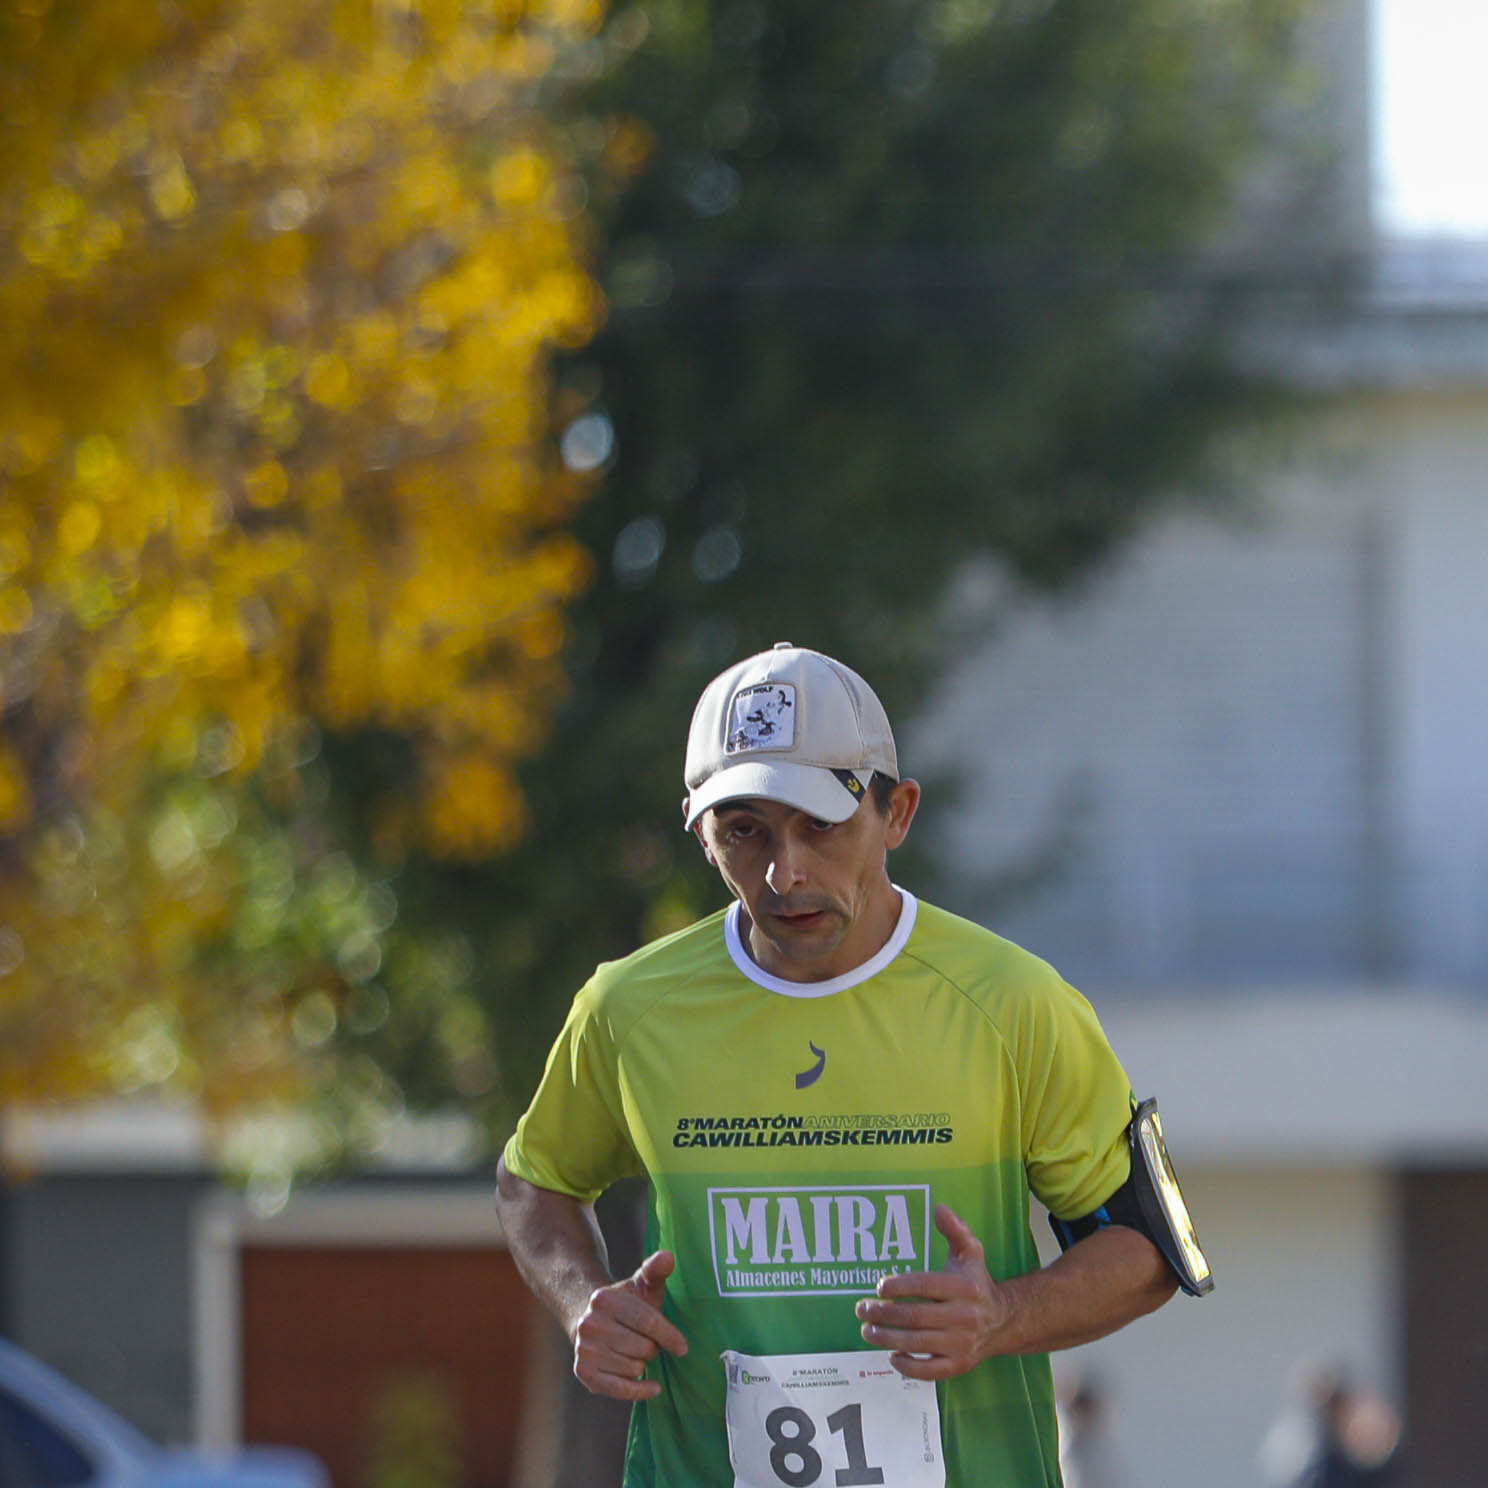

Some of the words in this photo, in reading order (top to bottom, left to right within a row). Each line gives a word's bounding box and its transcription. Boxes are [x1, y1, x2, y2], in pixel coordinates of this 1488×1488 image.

[672, 1128, 953, 1148] CAWILLIAMSKEMMIS
[721, 1194, 916, 1265] MAIRA
[726, 1270, 806, 1287] Almacenes
[765, 1403, 885, 1488] 81
